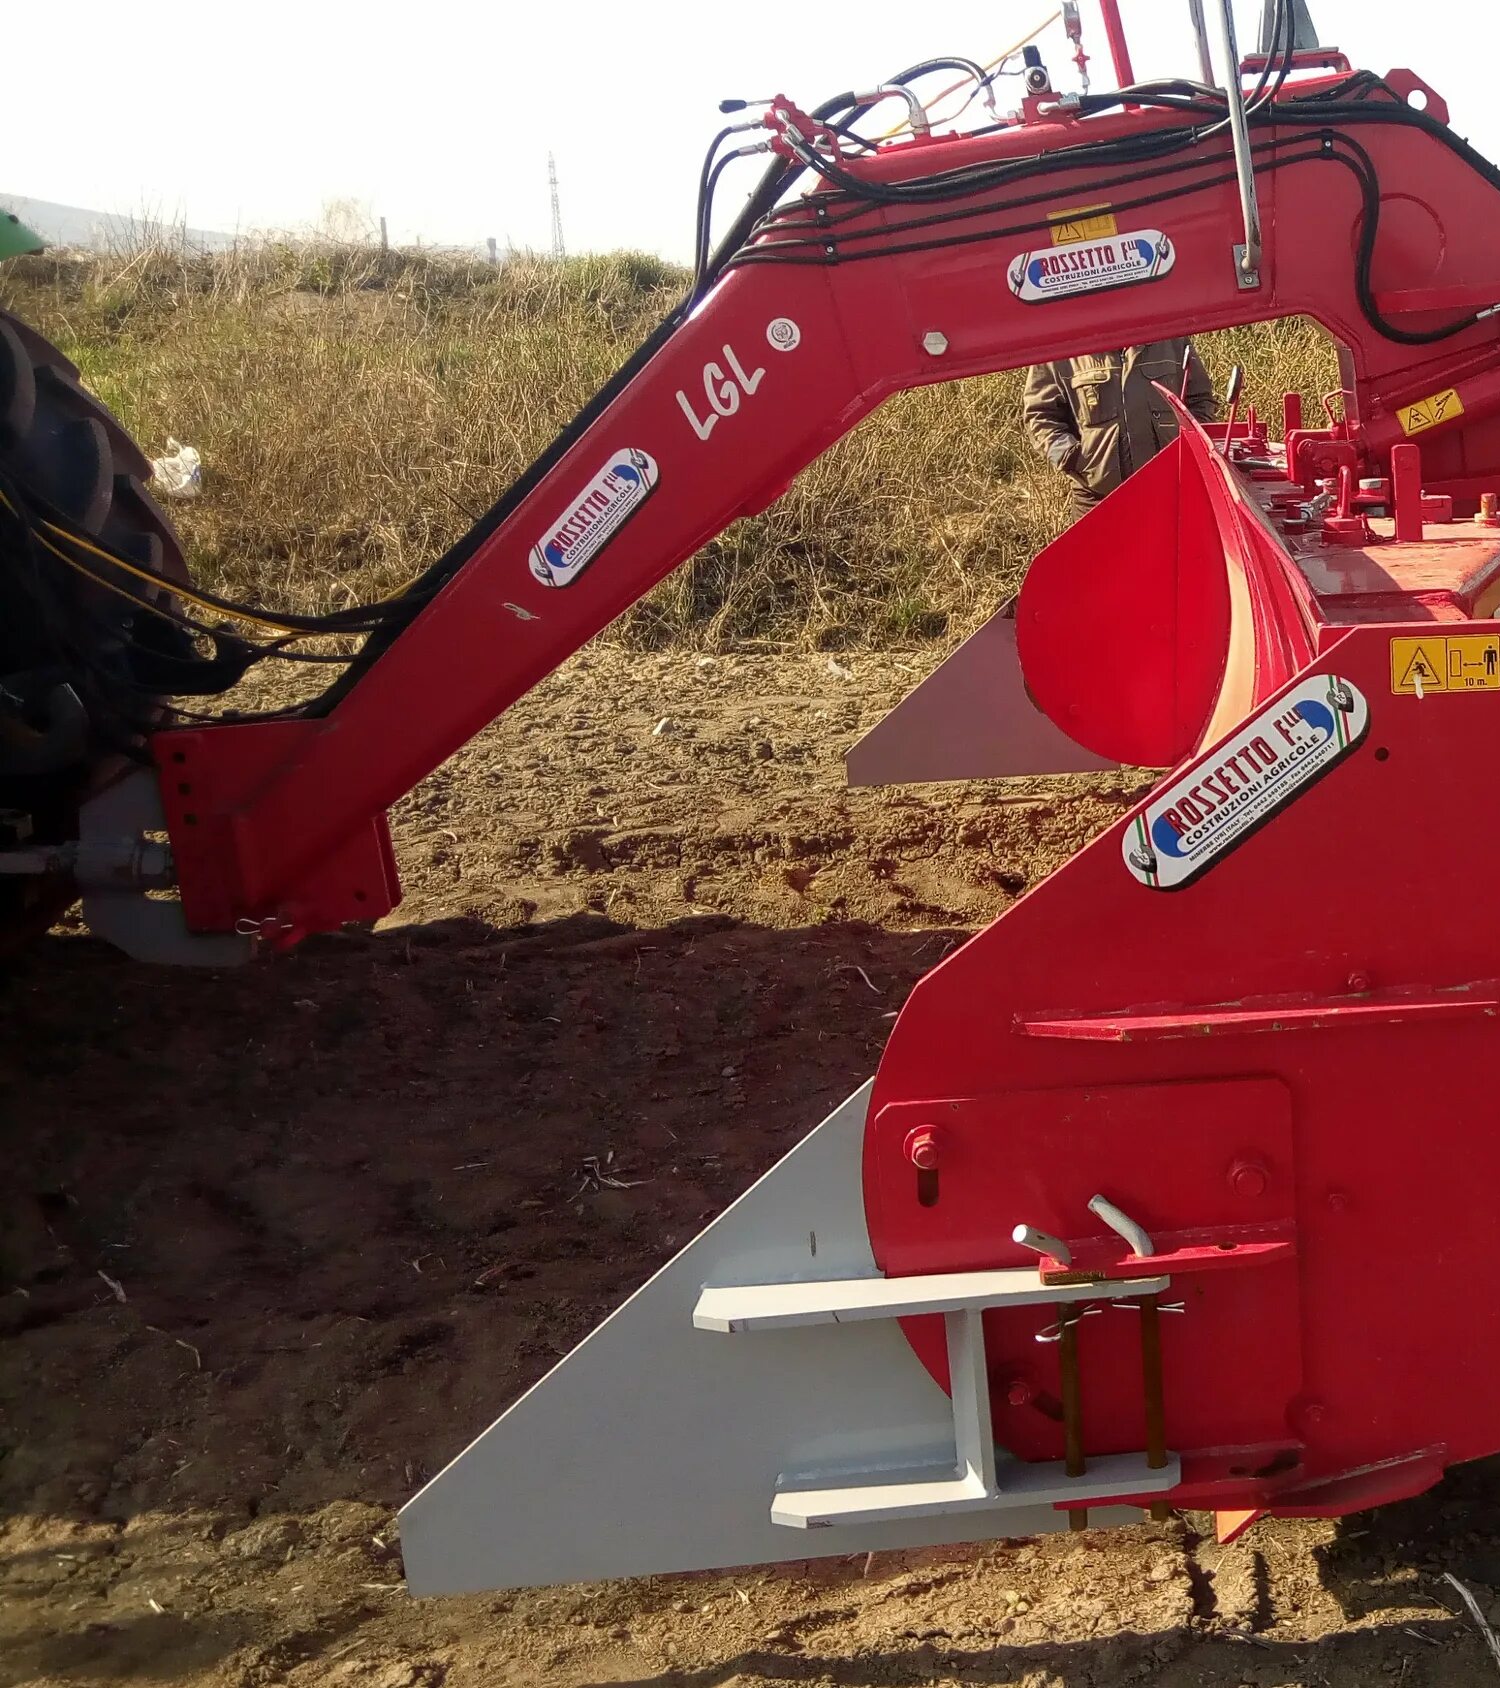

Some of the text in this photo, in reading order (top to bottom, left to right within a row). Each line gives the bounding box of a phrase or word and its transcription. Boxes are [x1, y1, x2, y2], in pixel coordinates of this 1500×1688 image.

[1040, 245, 1115, 276] ROSSETTO
[1044, 269, 1100, 284] COSTRUZIONI
[1101, 260, 1142, 274] AGRICOLE
[675, 344, 766, 440] LGL
[551, 489, 610, 556] ROSSETTO
[566, 515, 605, 559] COSTRUZIONI
[604, 484, 633, 518] AGRICOLE
[1464, 678, 1488, 686] 10 m.
[1162, 736, 1278, 837] ROSSETTO
[1186, 734, 1320, 845] COSTRUZIONI AGRICOLE
[1225, 818, 1240, 832] ITALY
